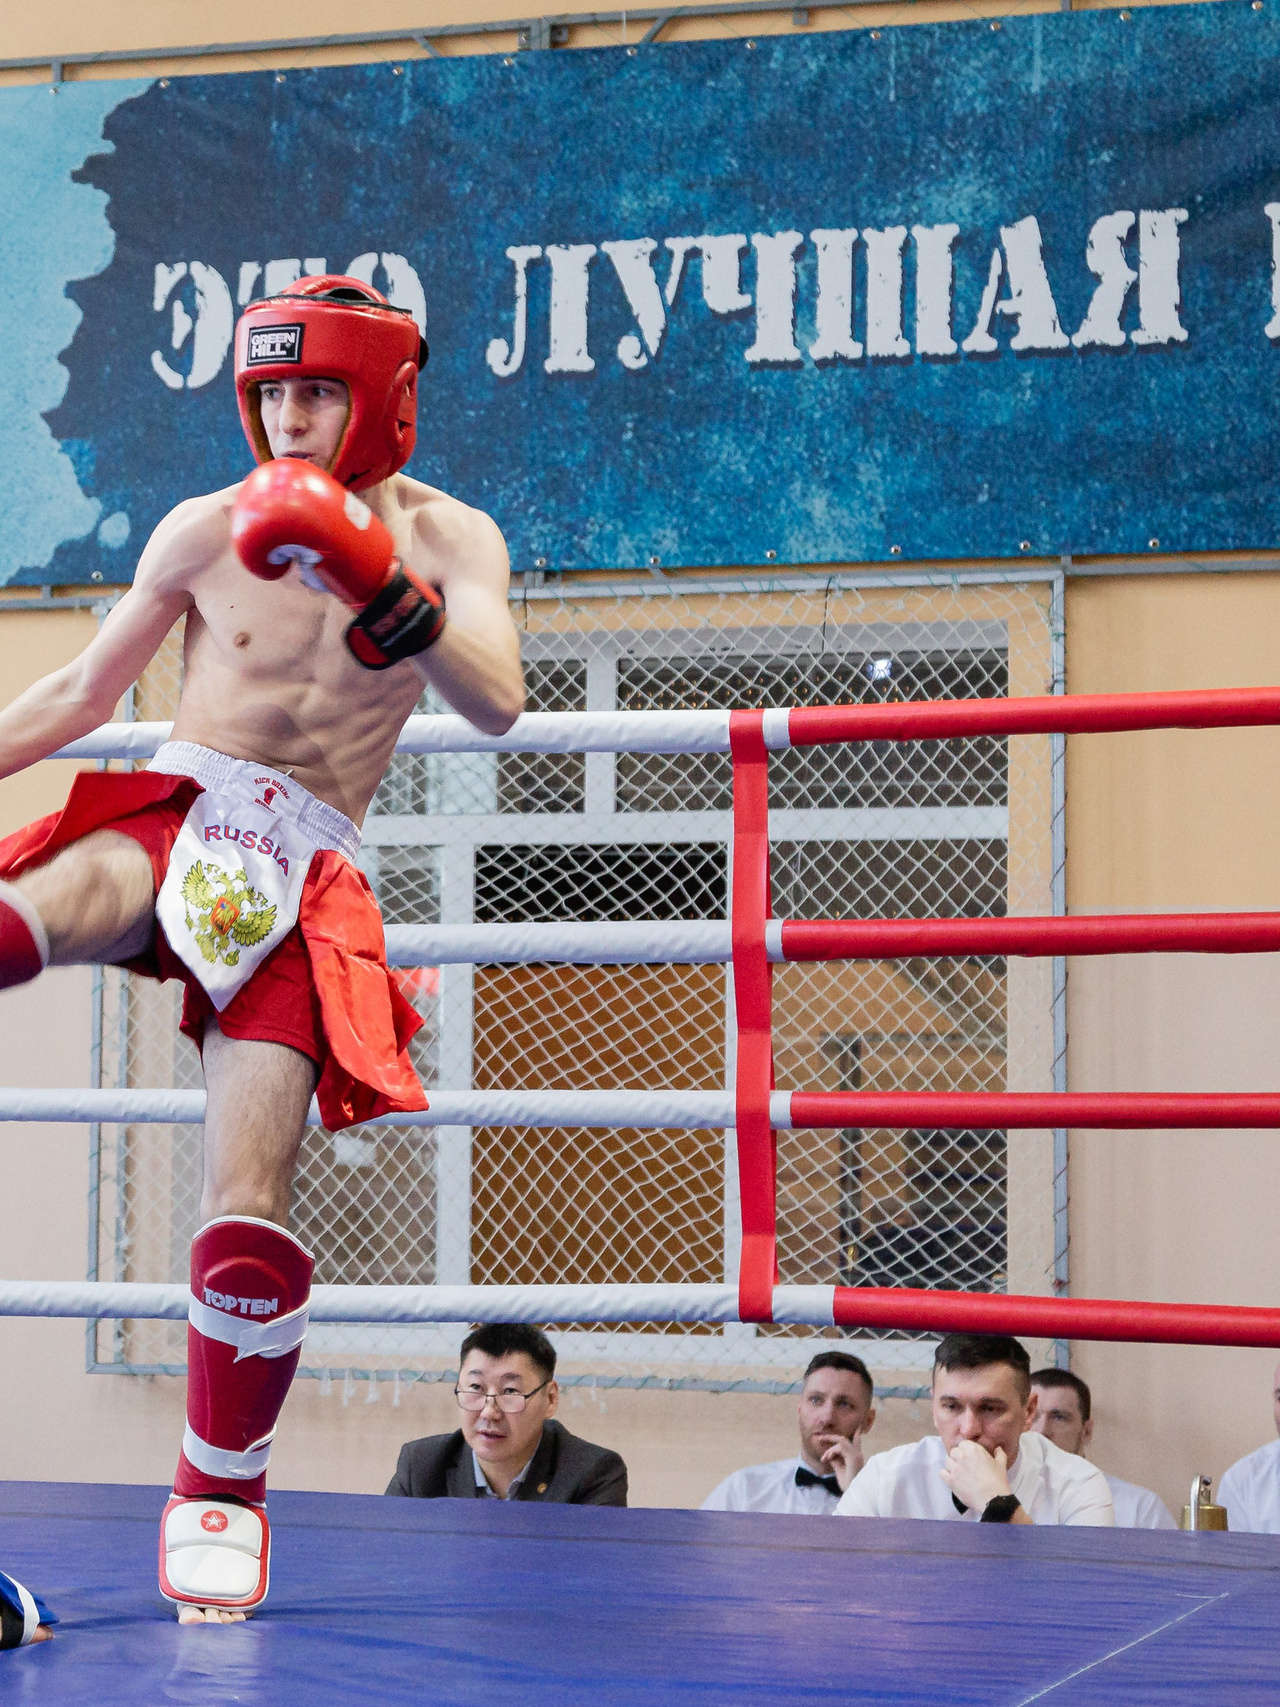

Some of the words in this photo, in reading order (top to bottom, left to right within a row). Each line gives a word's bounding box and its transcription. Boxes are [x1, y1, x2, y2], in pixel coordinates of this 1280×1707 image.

[486, 207, 1189, 377] ЛУЧШАЯ
[251, 332, 296, 346] GREEN
[251, 342, 287, 358] HILL
[204, 824, 289, 877] RUSSIA
